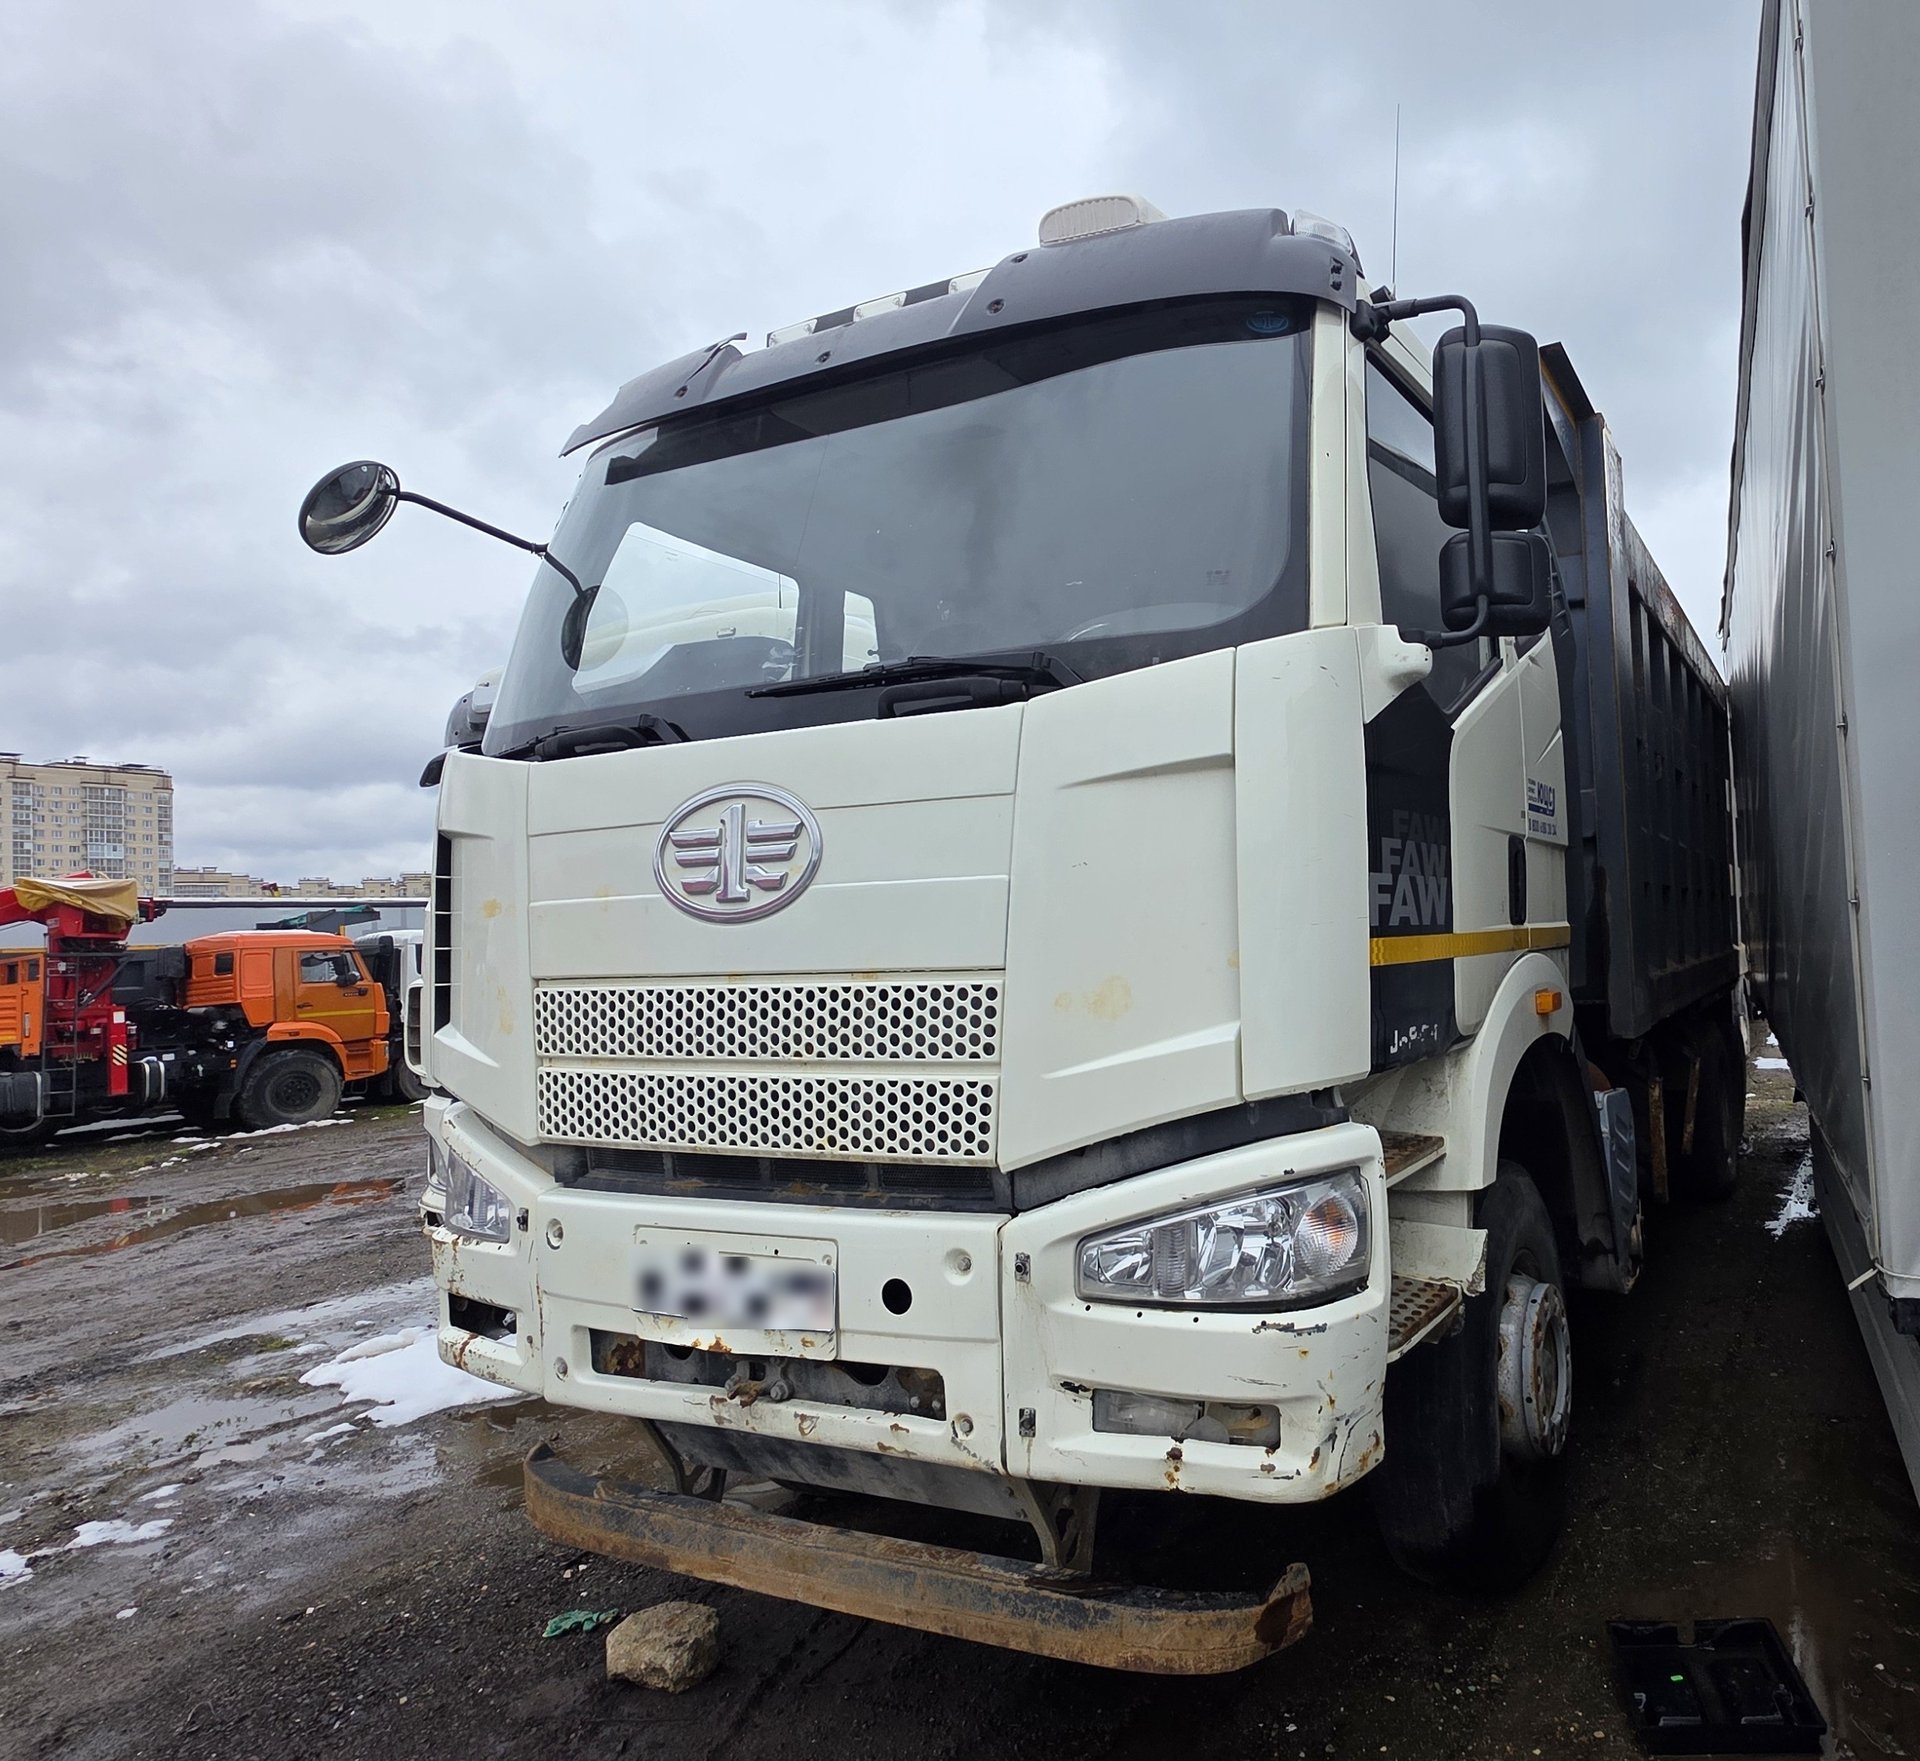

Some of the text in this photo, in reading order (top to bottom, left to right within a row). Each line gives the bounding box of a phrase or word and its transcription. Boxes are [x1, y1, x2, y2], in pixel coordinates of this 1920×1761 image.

[1392, 808, 1446, 845] FAW
[1381, 837, 1447, 879] FAW
[1369, 872, 1448, 926] FAW
